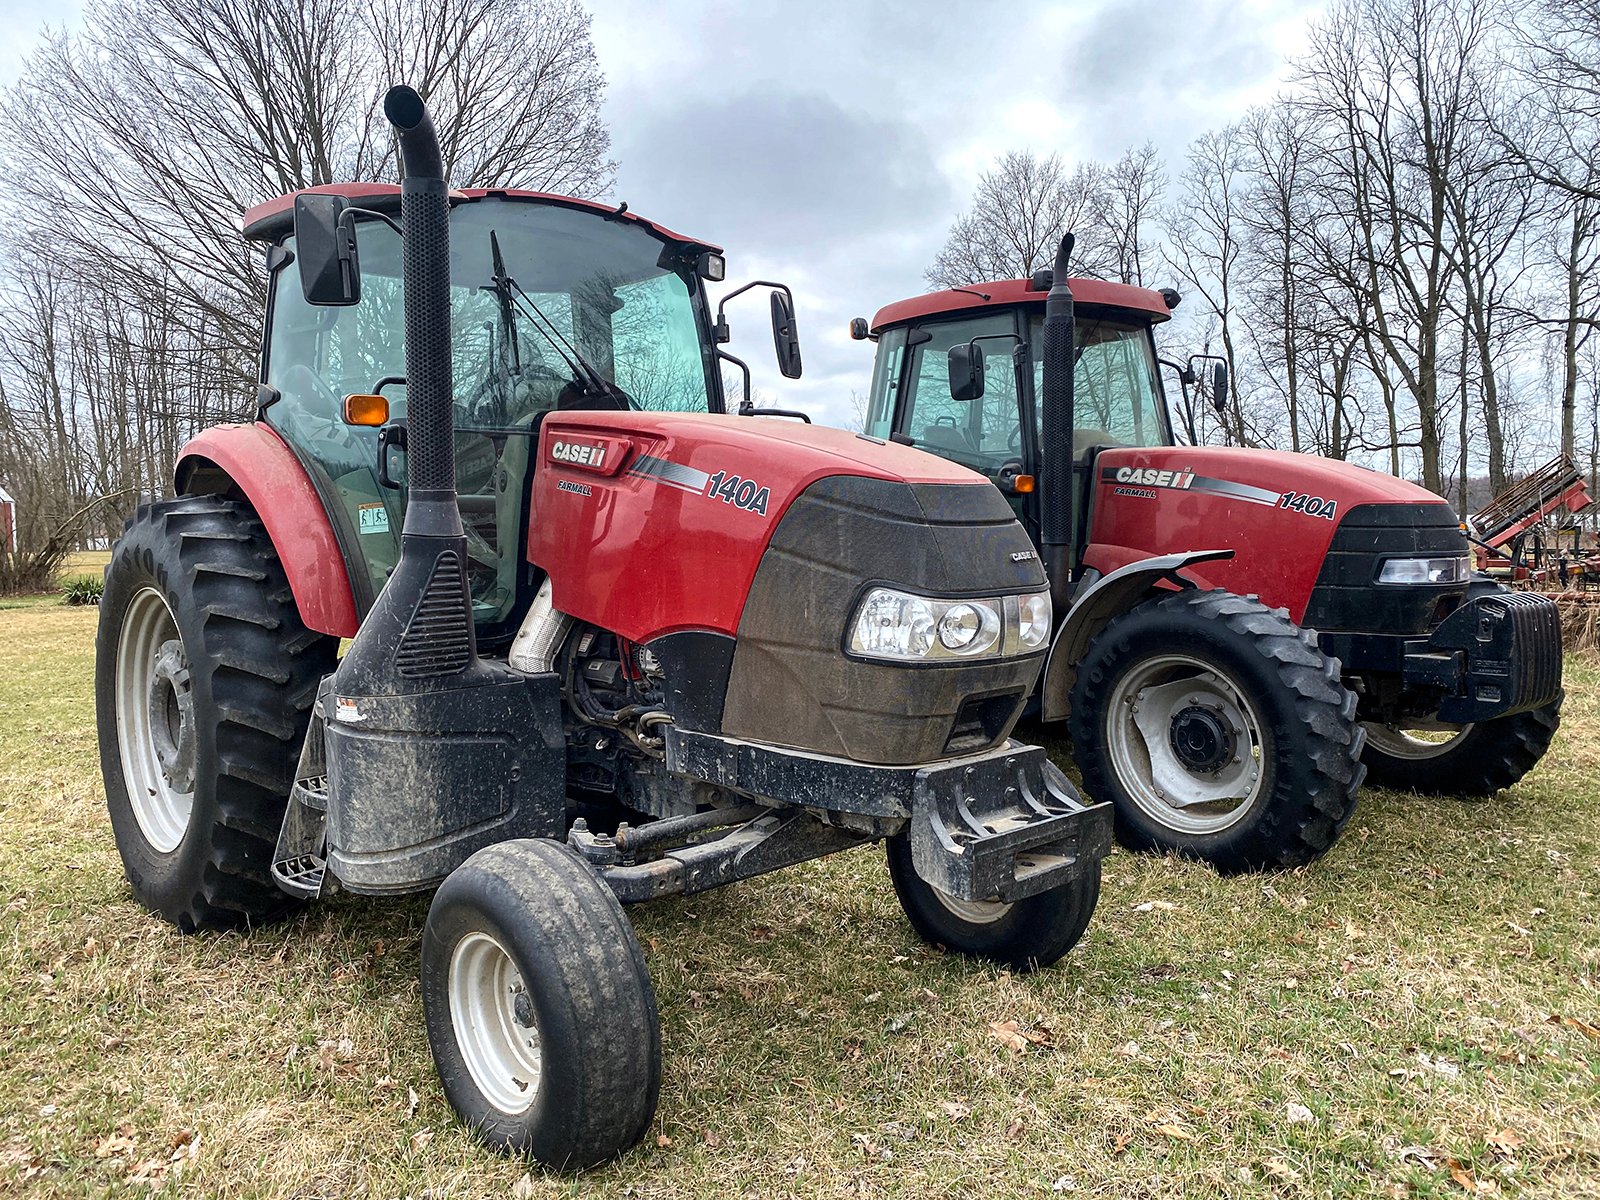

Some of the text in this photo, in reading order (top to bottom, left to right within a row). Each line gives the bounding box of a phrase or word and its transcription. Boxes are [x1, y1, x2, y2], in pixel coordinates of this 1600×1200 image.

[552, 441, 591, 464] CASE
[1115, 467, 1173, 487] CASE
[557, 480, 593, 497] FARMALL
[708, 470, 771, 518] 140A
[1113, 487, 1157, 499] FARMALL
[1279, 491, 1338, 521] 140A
[1011, 551, 1032, 562] CASE
